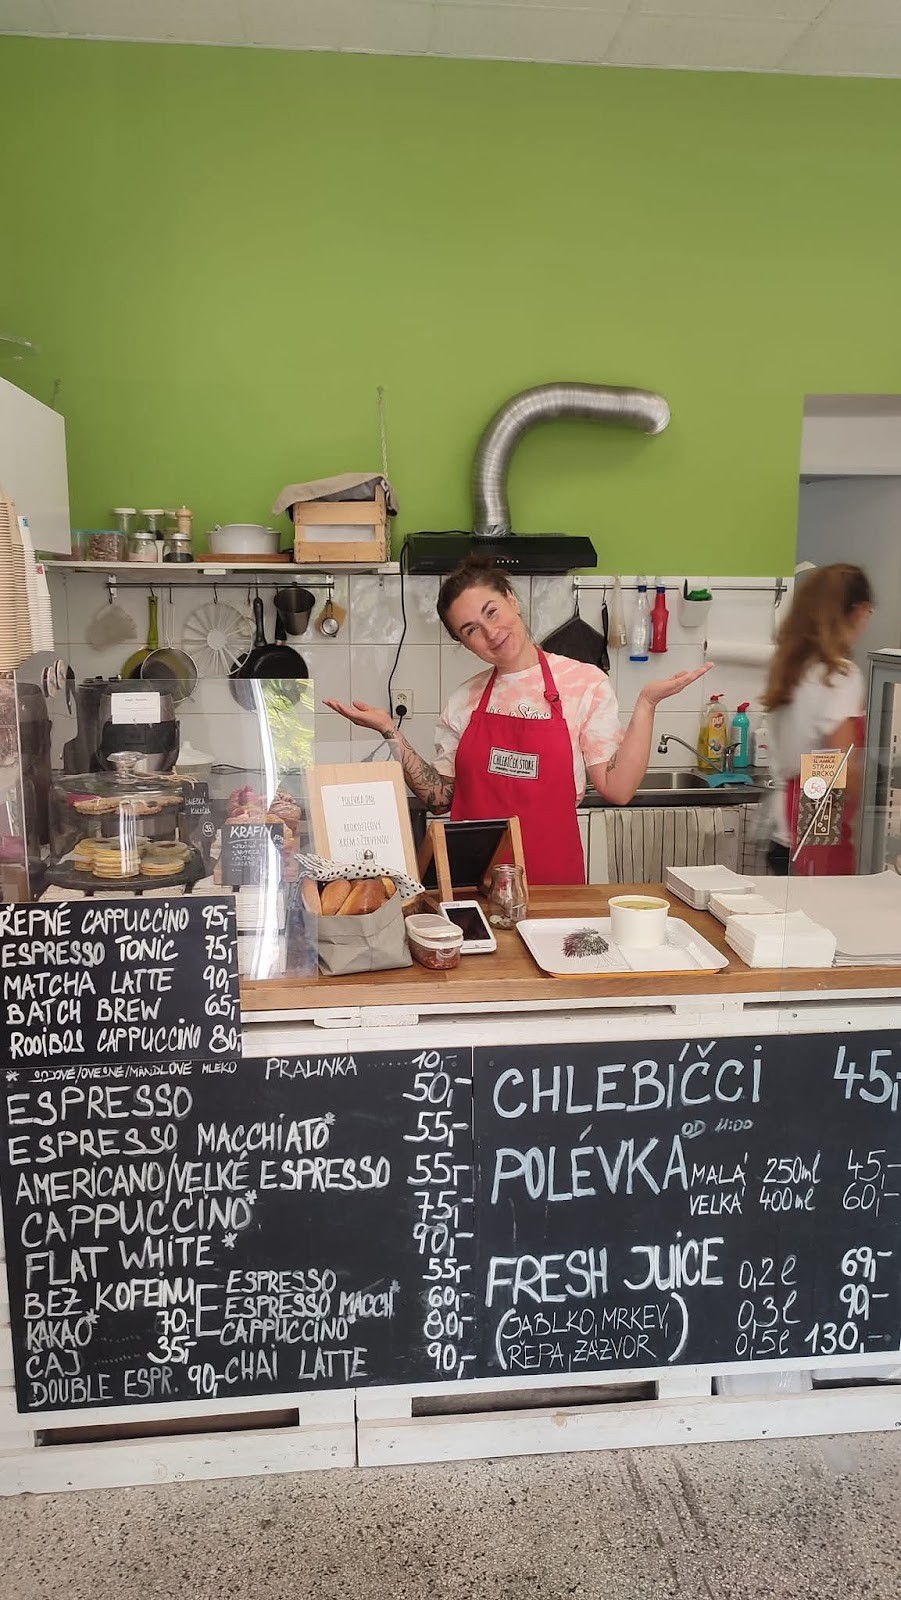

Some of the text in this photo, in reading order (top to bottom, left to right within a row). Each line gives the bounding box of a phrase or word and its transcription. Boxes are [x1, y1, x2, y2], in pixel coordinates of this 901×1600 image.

[0, 903, 235, 937] ŘEPNÉ CAPPUCCINO 95,-
[1, 934, 237, 968] ESPRESSO TONIC 75,-
[4, 965, 239, 1000] MATCHA LATTE 90,-
[6, 998, 81, 1026] BATCH
[97, 997, 161, 1024] BREW
[97, 1018, 201, 1053] CAPPUCCINO
[265, 1055, 358, 1081] PRALINKA
[493, 1041, 762, 1118] CHLEBÍČCI
[7, 1072, 472, 1126] ESPRESSO 50,-
[8, 1123, 178, 1165] ESPRESSO
[403, 1111, 469, 1147] 55,-
[260, 1156, 391, 1192] ESPRESSO
[407, 1152, 470, 1186] 55,-
[490, 1123, 688, 1205] POLÉVKA
[690, 1152, 748, 1187] MALÁ
[690, 1186, 746, 1216] VELKÁ
[25, 1246, 109, 1290] FLAT
[119, 1235, 215, 1269] WHITE
[225, 1258, 471, 1294] ESPRESSO 55,-
[485, 1247, 609, 1308] FRESH
[623, 1230, 725, 1292] JUICE
[841, 1246, 893, 1283] 69,-
[23, 1287, 83, 1319] BEZ
[224, 1292, 331, 1319] ESPRESSO
[427, 1285, 470, 1312] 60,-
[423, 1308, 474, 1340] 80,-
[804, 1321, 884, 1354] 130,-
[147, 1335, 198, 1365] 35,-
[225, 1344, 279, 1384] CHAI
[299, 1346, 368, 1382] LATTE
[28, 1375, 113, 1407] DOUBLE
[124, 1366, 179, 1398] ESPR.
